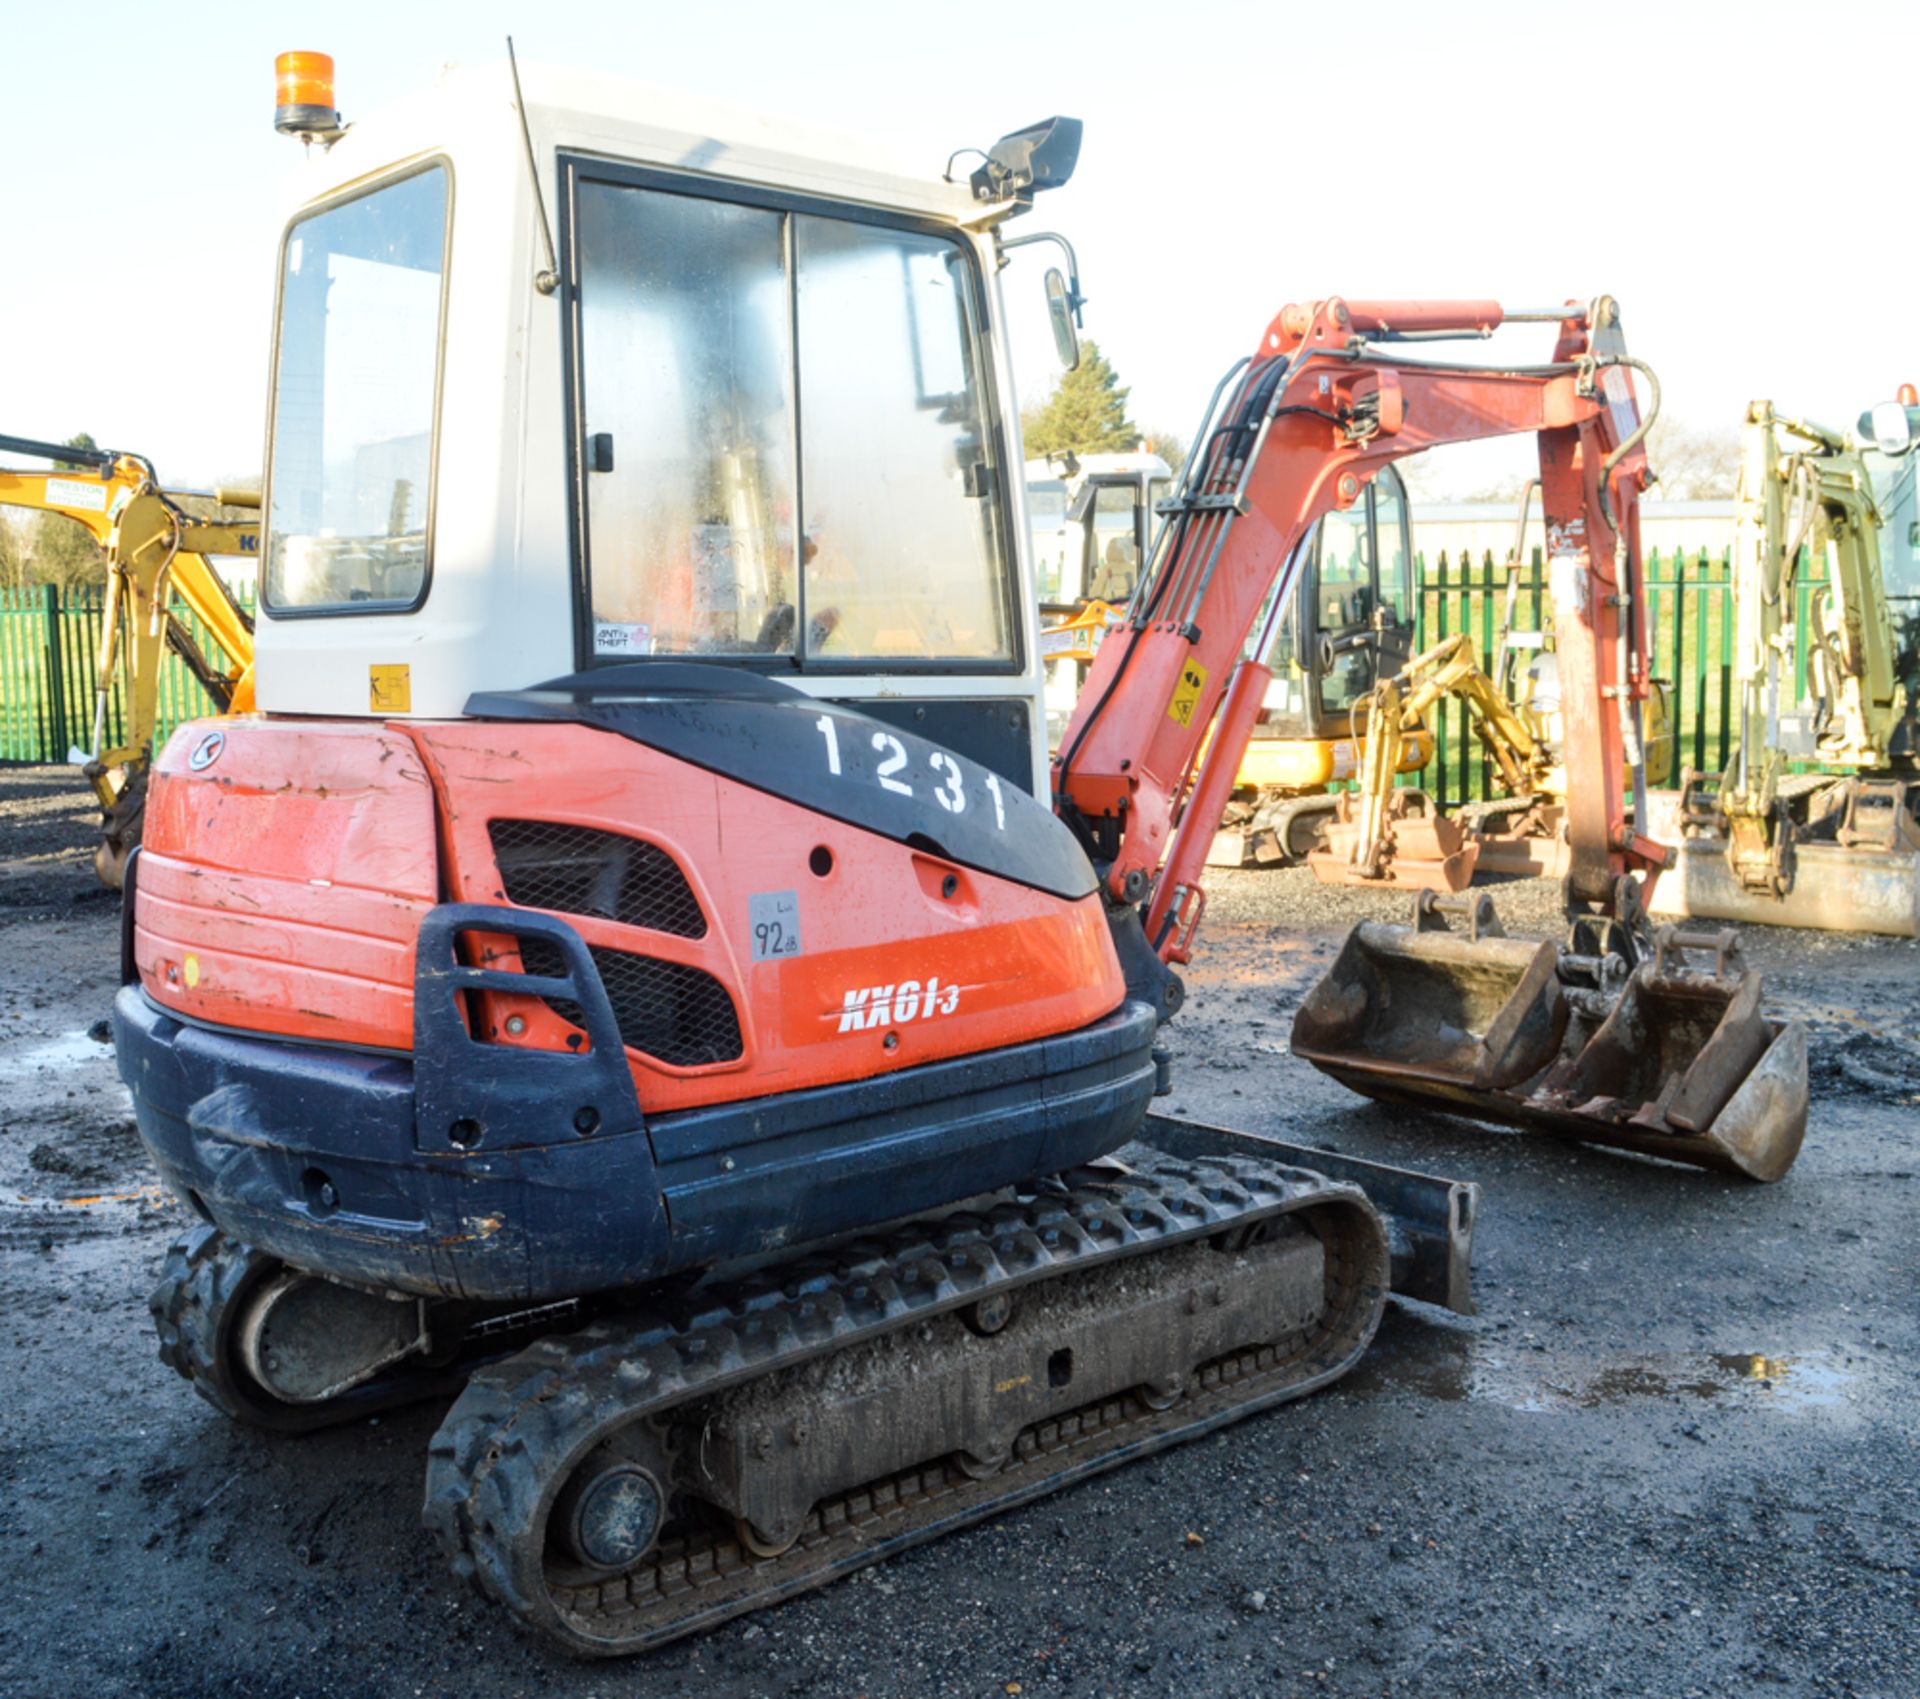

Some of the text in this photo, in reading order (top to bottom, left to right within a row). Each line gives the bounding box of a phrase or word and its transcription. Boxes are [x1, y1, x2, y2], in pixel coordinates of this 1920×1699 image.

[597, 639, 628, 648] THEFT
[816, 716, 1005, 830] 1231
[755, 920, 784, 956] 92
